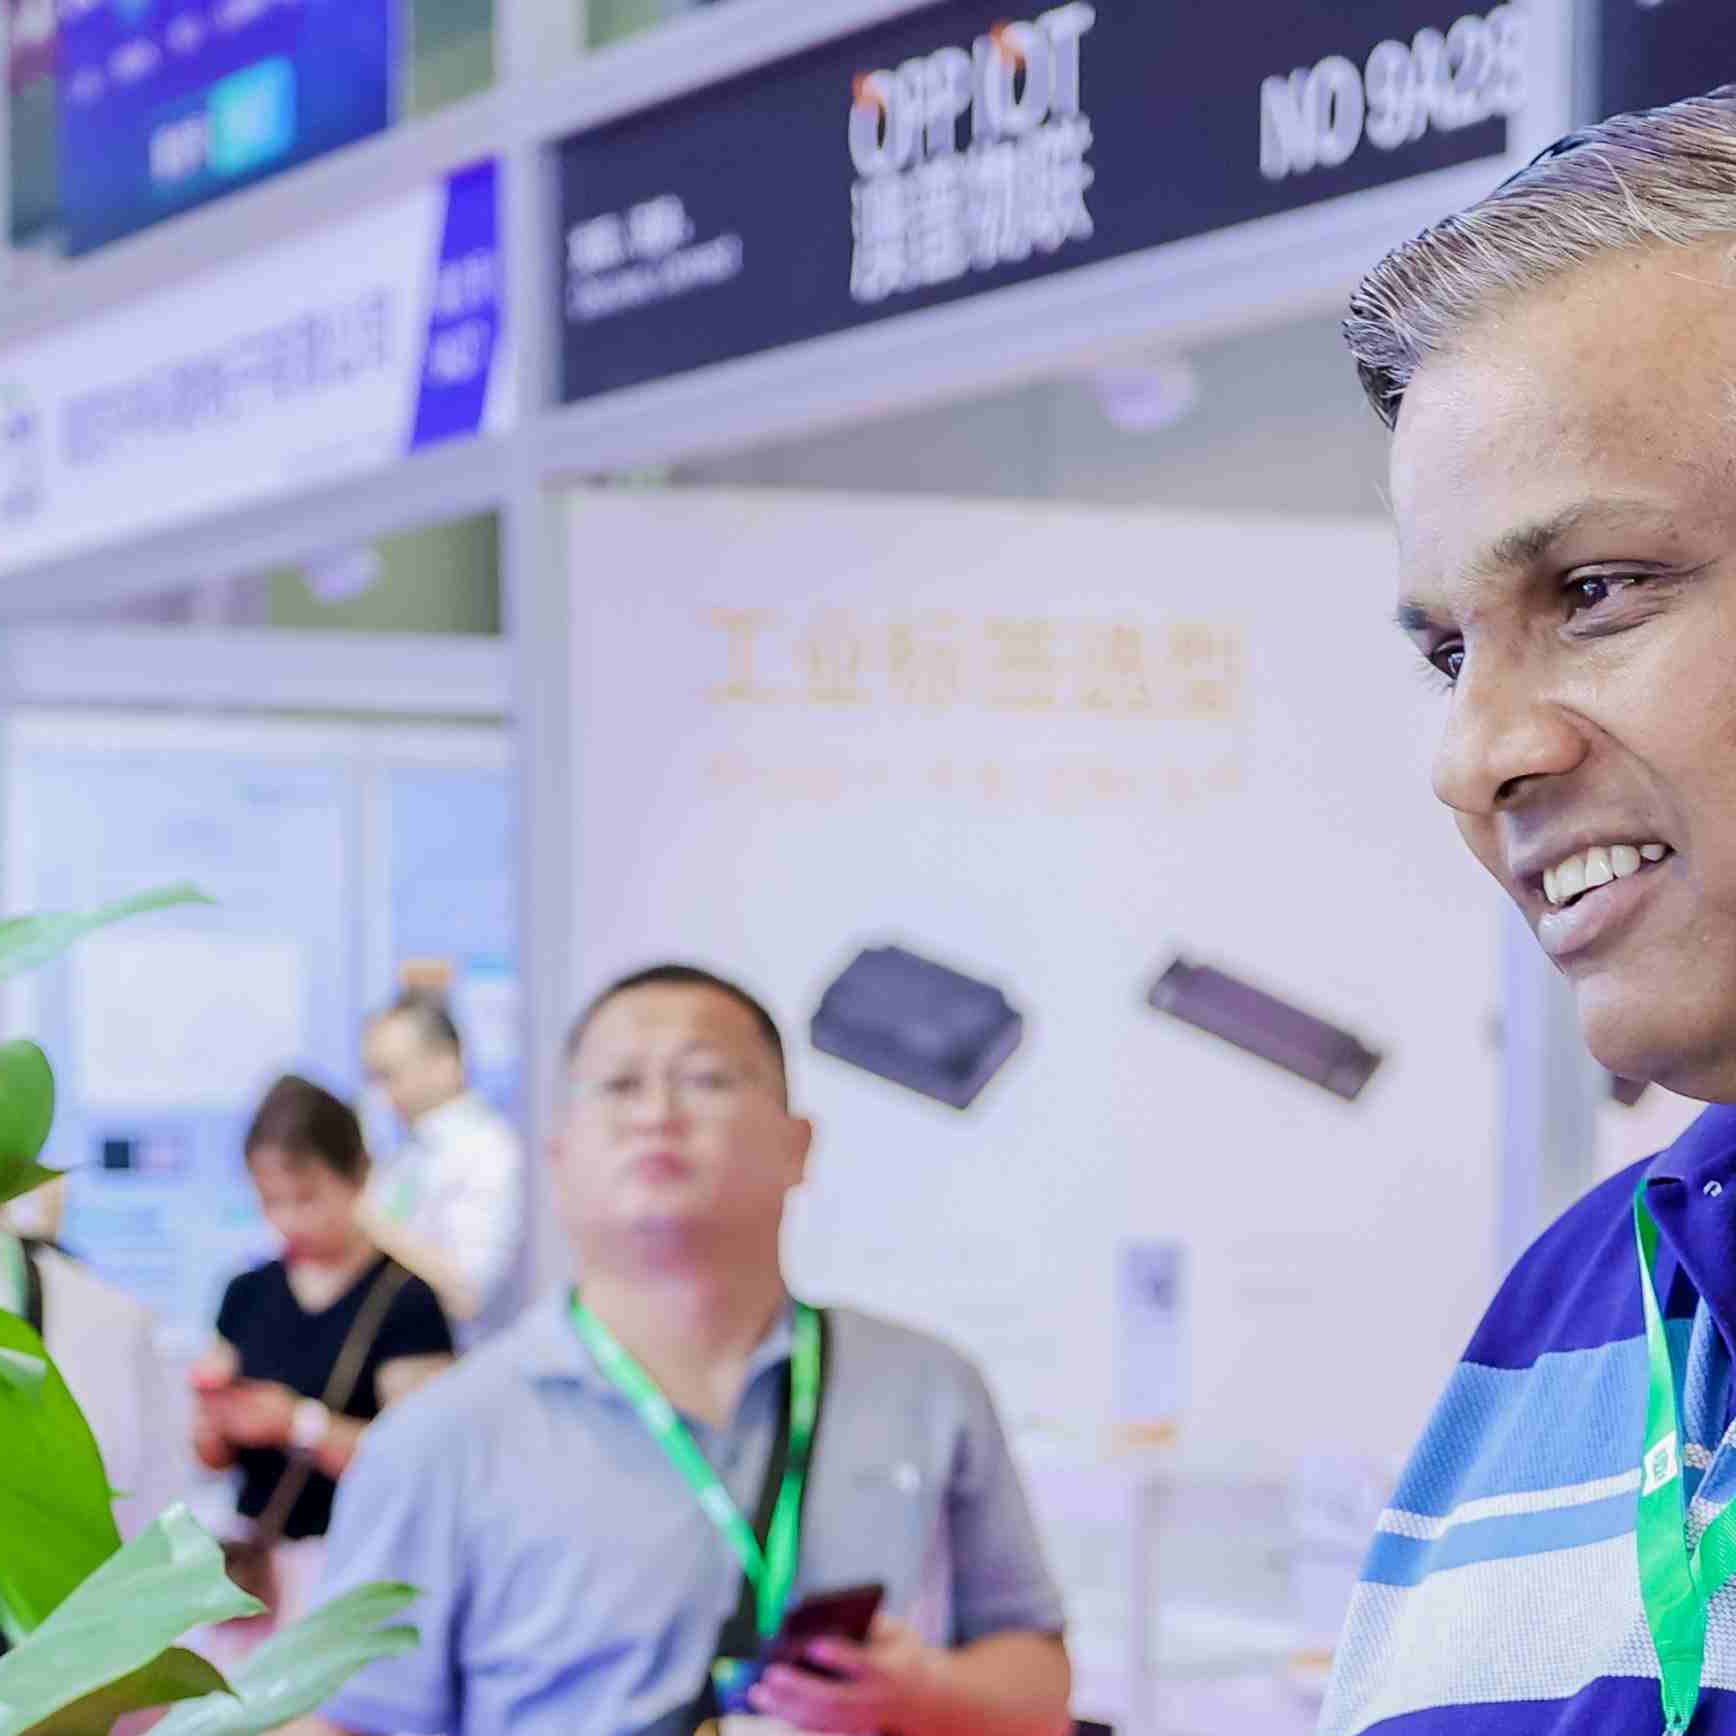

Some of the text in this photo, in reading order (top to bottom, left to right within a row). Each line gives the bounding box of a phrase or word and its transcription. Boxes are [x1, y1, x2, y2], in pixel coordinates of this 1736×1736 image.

[850, 1, 1096, 179] OPP IOT
[1260, 55, 1364, 179] NO
